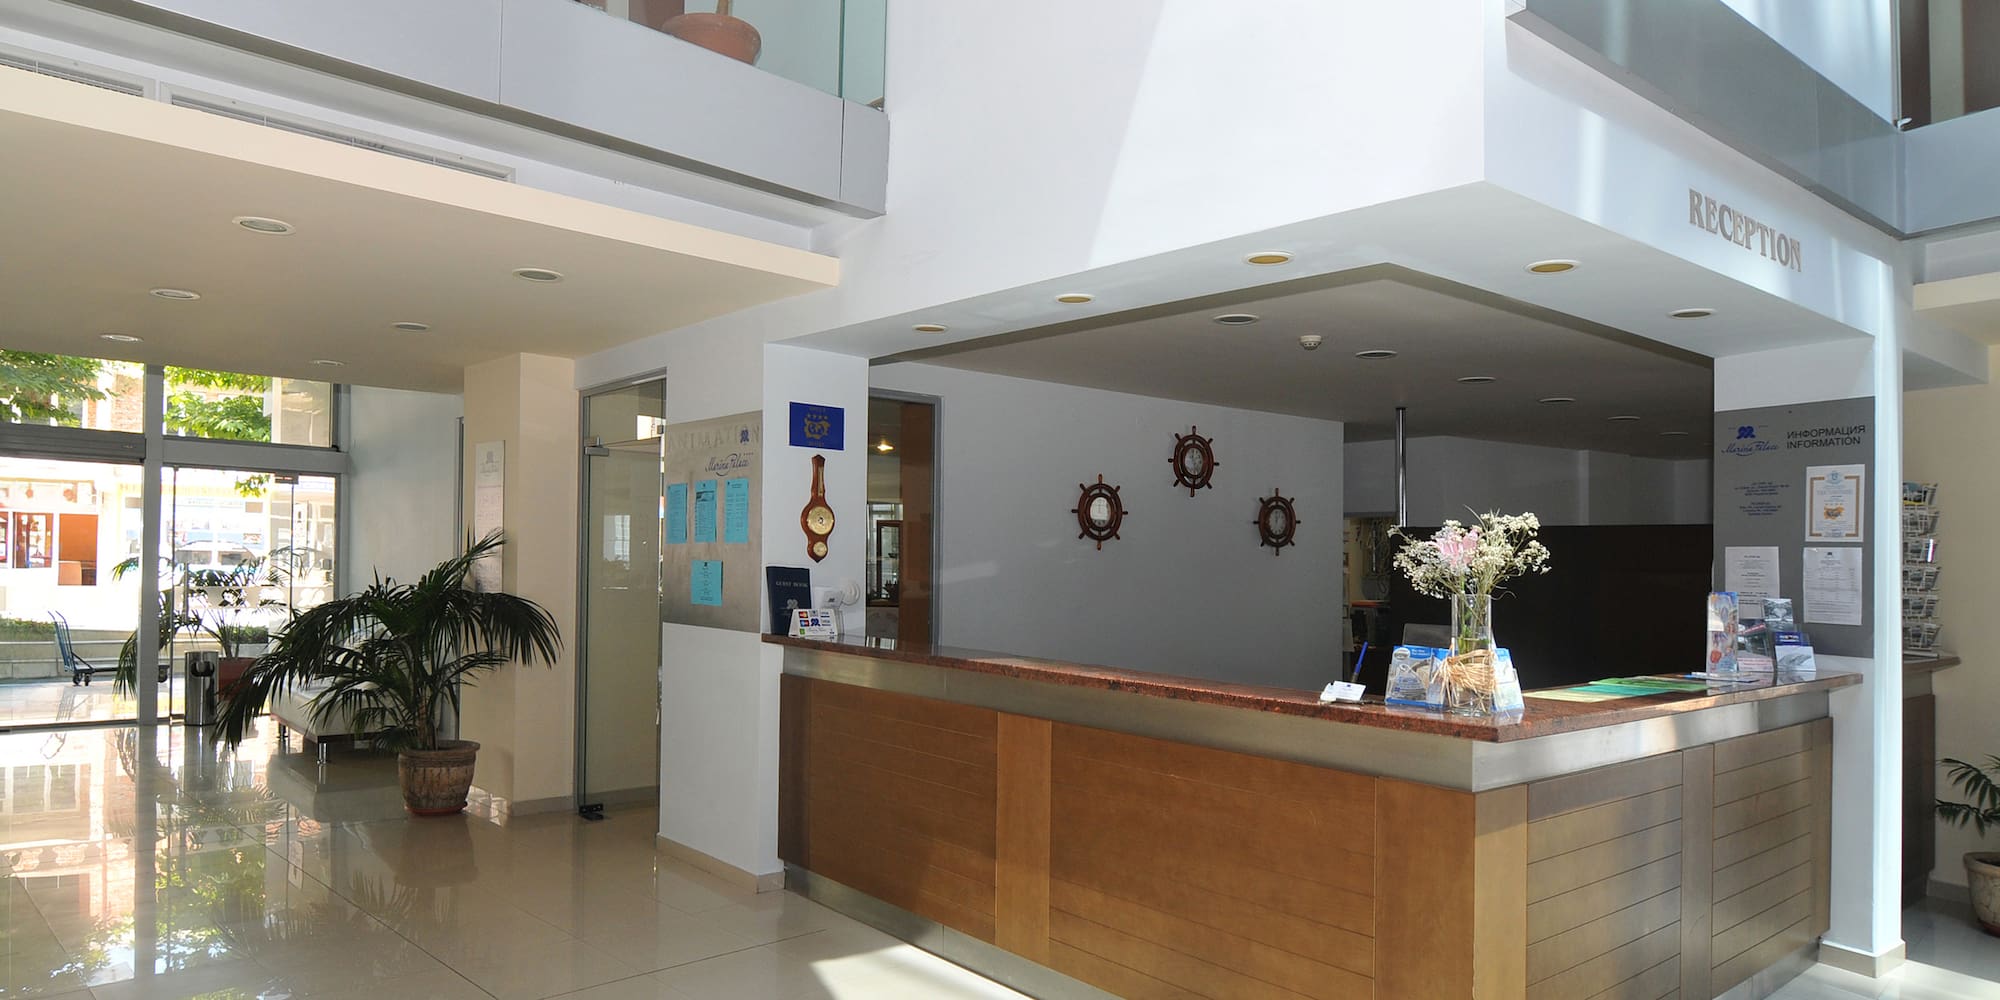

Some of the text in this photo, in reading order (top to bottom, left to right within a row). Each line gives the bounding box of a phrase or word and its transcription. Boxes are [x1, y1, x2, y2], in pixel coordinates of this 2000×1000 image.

[1688, 188, 1802, 272] RECEPTION
[1787, 425, 1866, 439] ИНФОРМАЦИЯ
[1721, 443, 1753, 454] Marina
[1787, 436, 1861, 449] INFORMATION
[705, 456, 729, 472] Marina
